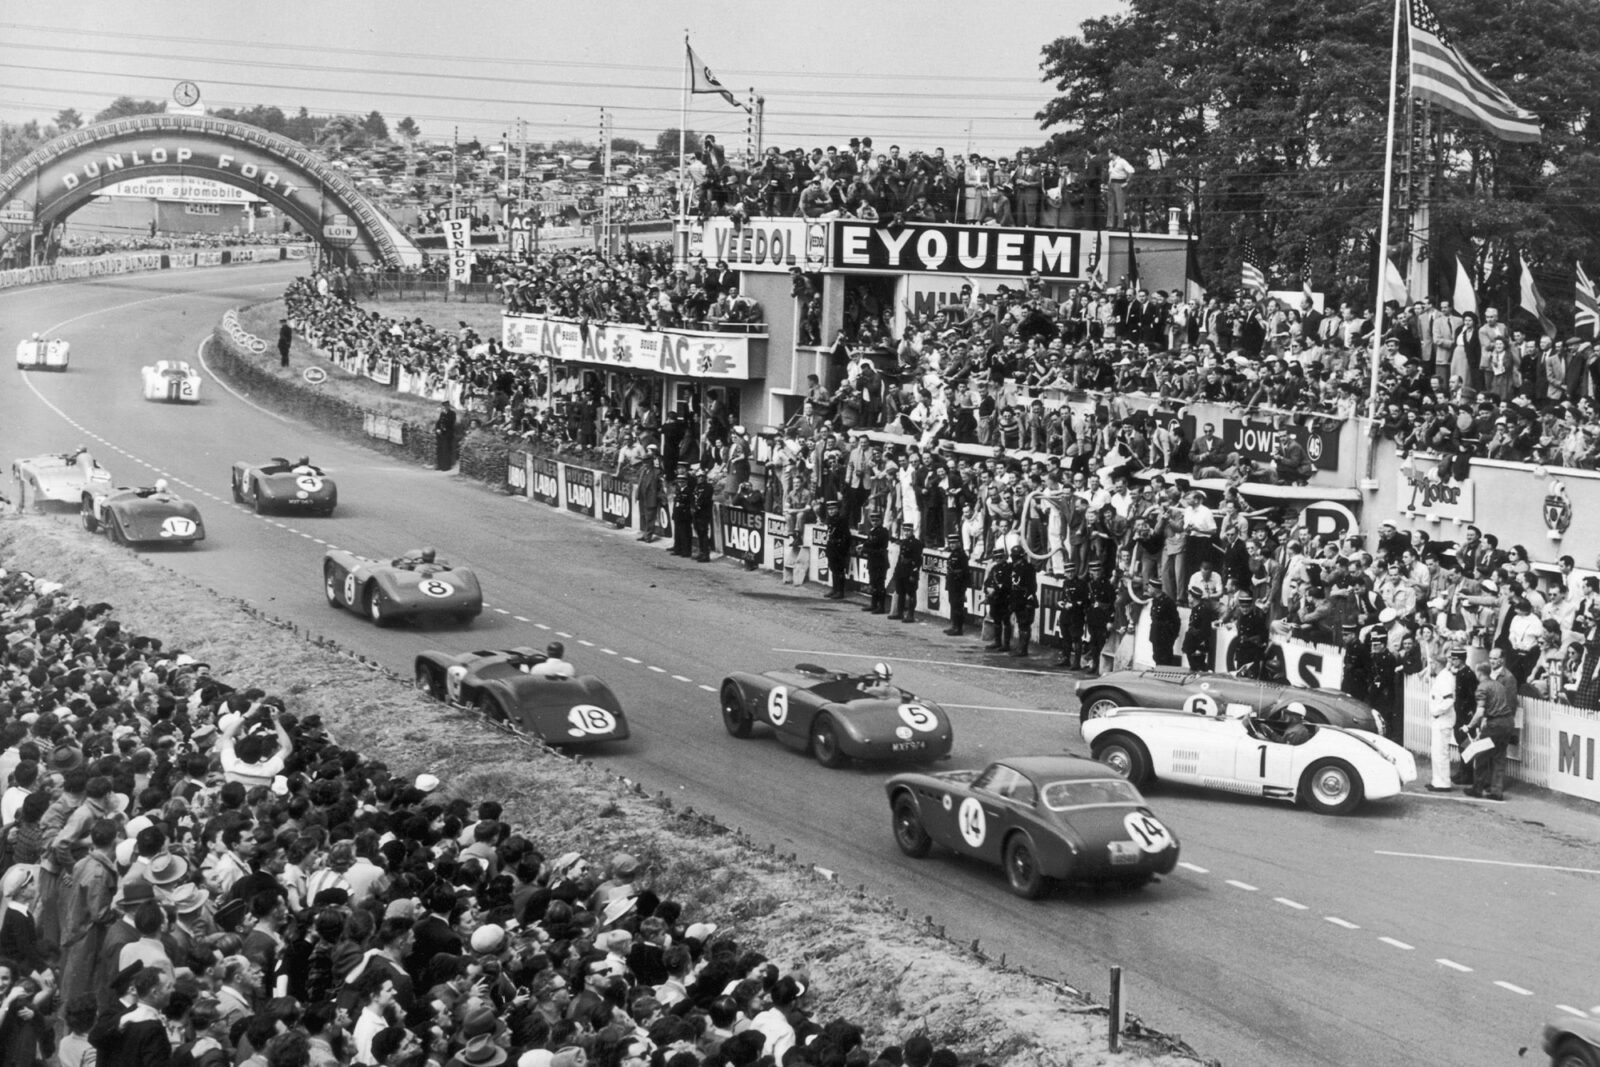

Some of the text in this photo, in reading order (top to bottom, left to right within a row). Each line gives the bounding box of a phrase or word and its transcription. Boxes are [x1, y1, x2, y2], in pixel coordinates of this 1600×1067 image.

[62, 147, 298, 198] DUNLOP FORT
[172, 186, 242, 198] automobile
[329, 227, 352, 236] LOIN
[511, 216, 531, 229] AC
[450, 222, 466, 276] DUNLOP
[715, 227, 796, 266] VEEDOL
[842, 225, 1072, 273] EYQUEM
[541, 322, 561, 356] AC
[581, 324, 607, 362] AC
[660, 335, 690, 375] AC
[182, 381, 193, 396] 2
[1234, 428, 1321, 457] JOWE 46
[302, 478, 316, 487] 4
[534, 472, 558, 498] LABO
[567, 483, 593, 508] LABO
[1407, 476, 1461, 511] Motor
[603, 491, 630, 518] LABO
[170, 520, 190, 532] 17
[724, 524, 762, 554] LABO
[427, 580, 447, 595] 8
[577, 708, 609, 729] 18
[773, 692, 783, 720] 5
[908, 706, 928, 724] 5
[1192, 698, 1207, 715] 6
[1258, 745, 1267, 778] 1
[965, 804, 981, 838] 14
[1130, 817, 1164, 847] 14
